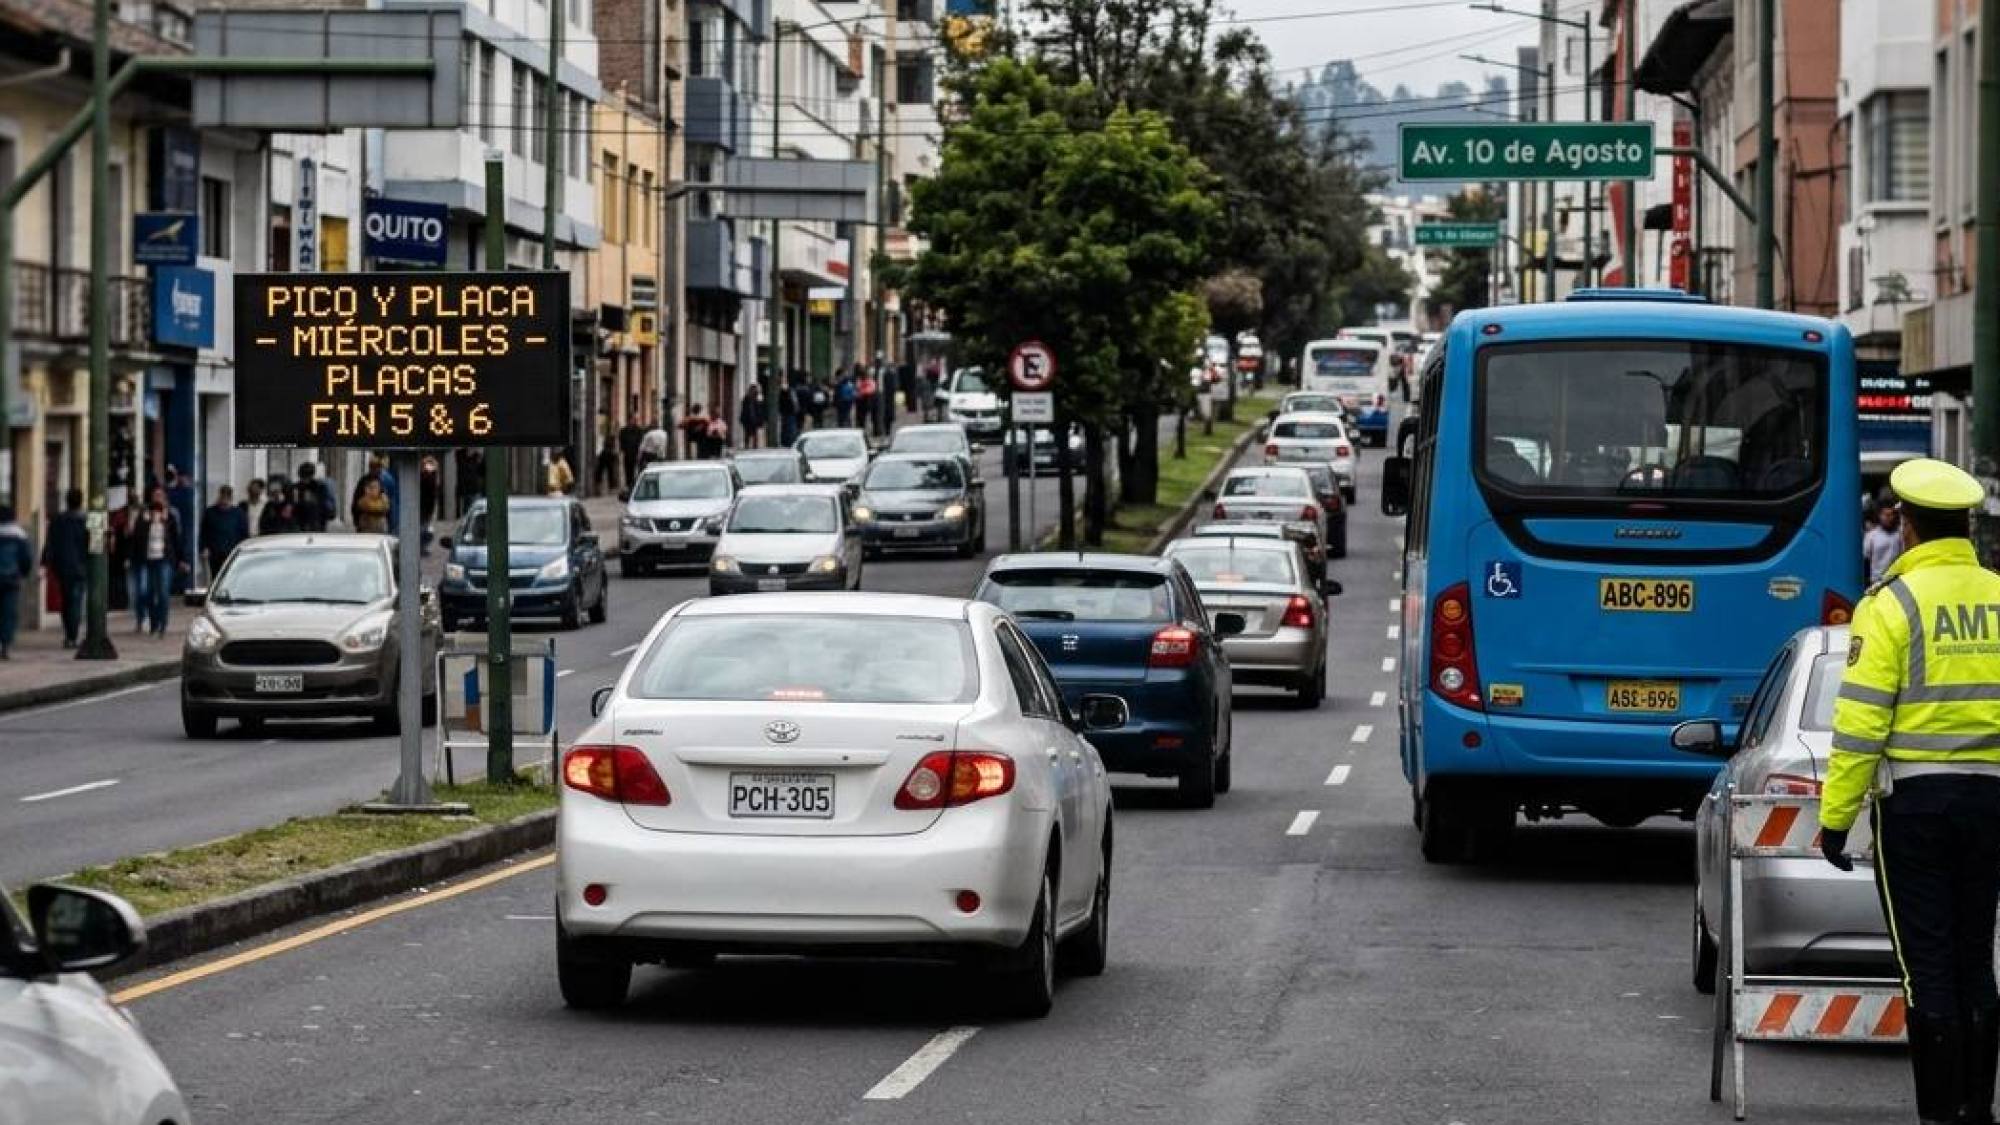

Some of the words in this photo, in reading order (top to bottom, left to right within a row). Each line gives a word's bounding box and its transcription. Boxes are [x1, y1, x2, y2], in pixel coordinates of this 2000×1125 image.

[1412, 140, 1454, 164] Av.
[1464, 139, 1495, 164] 10
[1504, 140, 1536, 163] de
[1546, 138, 1643, 170] Agosto
[366, 212, 443, 242] QUITO
[268, 286, 357, 317] PICO
[372, 286, 396, 317] Y
[411, 286, 534, 317] PLACA
[293, 319, 509, 356] MIÉRCOLES
[327, 365, 476, 396] PLACAS
[311, 404, 376, 435] FIN
[391, 404, 414, 435] 5
[429, 404, 454, 435] &
[469, 403, 492, 435] 6
[1603, 582, 1690, 609] ABC-896
[733, 785, 830, 812] PCH-305
